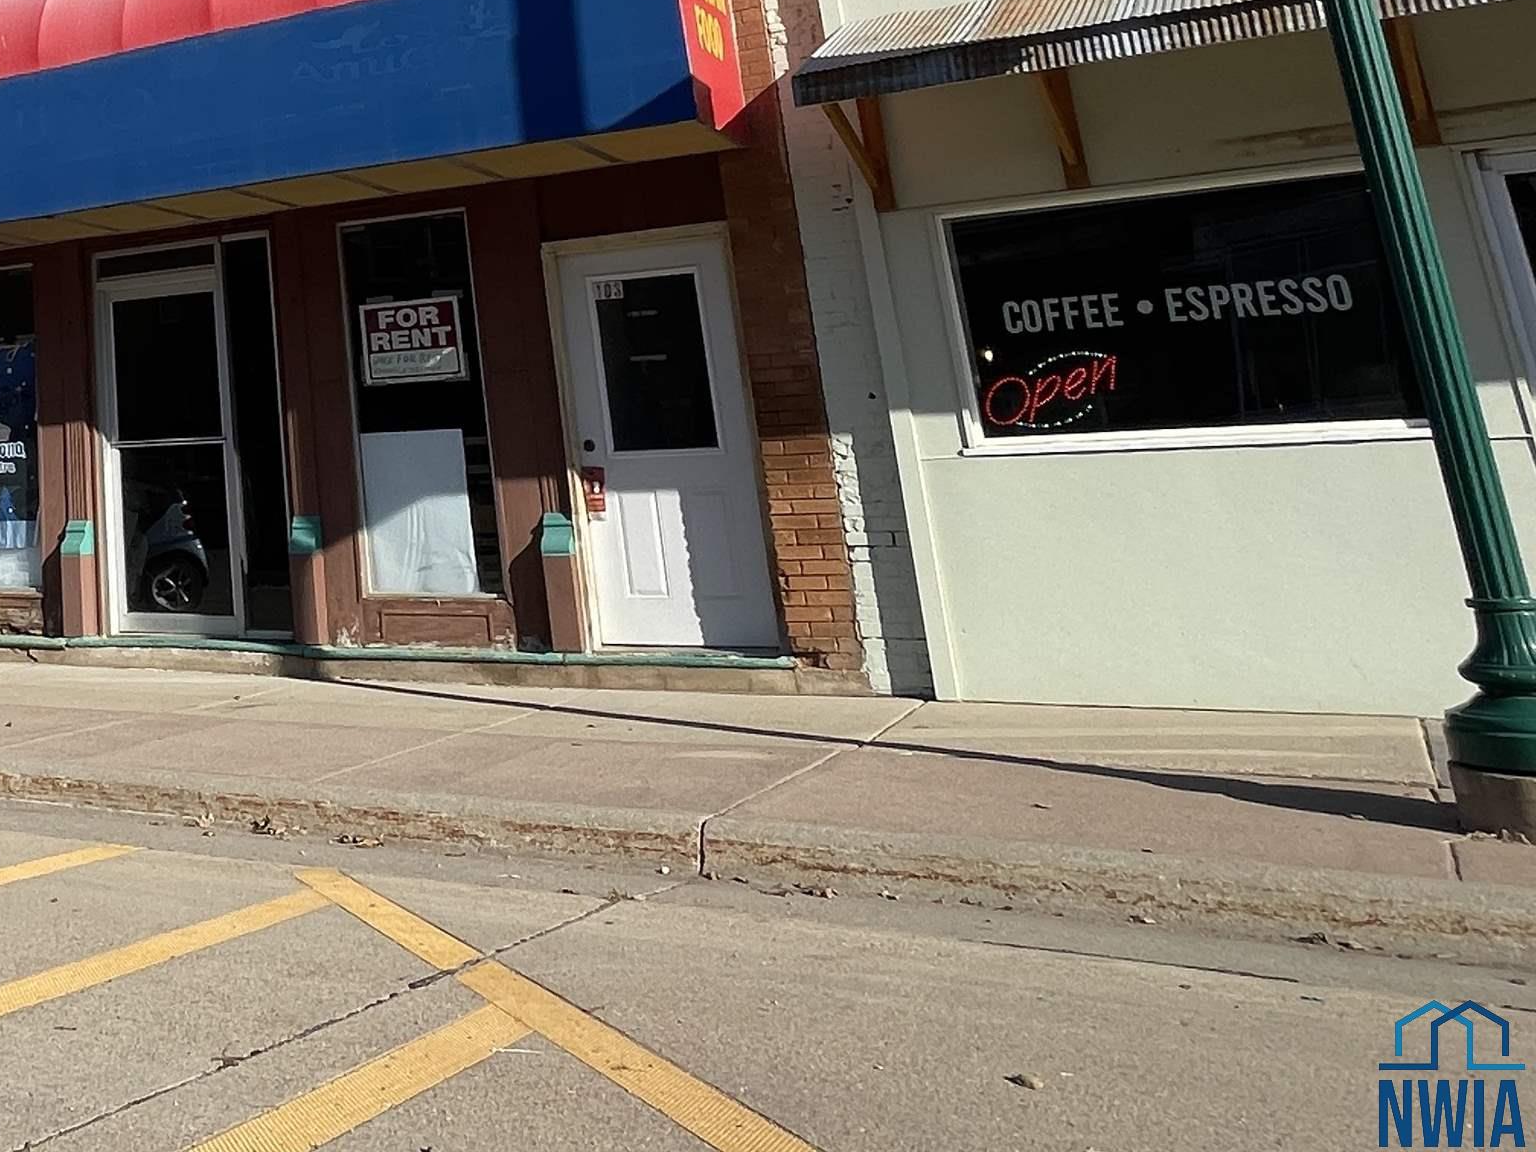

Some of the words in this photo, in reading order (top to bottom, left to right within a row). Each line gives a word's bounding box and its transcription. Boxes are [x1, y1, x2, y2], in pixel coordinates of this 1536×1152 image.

[693, 4, 725, 61] FOOD
[377, 305, 440, 330] FOR
[1002, 293, 1124, 334] COFFEE
[1164, 274, 1353, 322] ESPRESSO
[370, 325, 452, 352] RENT
[985, 353, 1117, 425] Open
